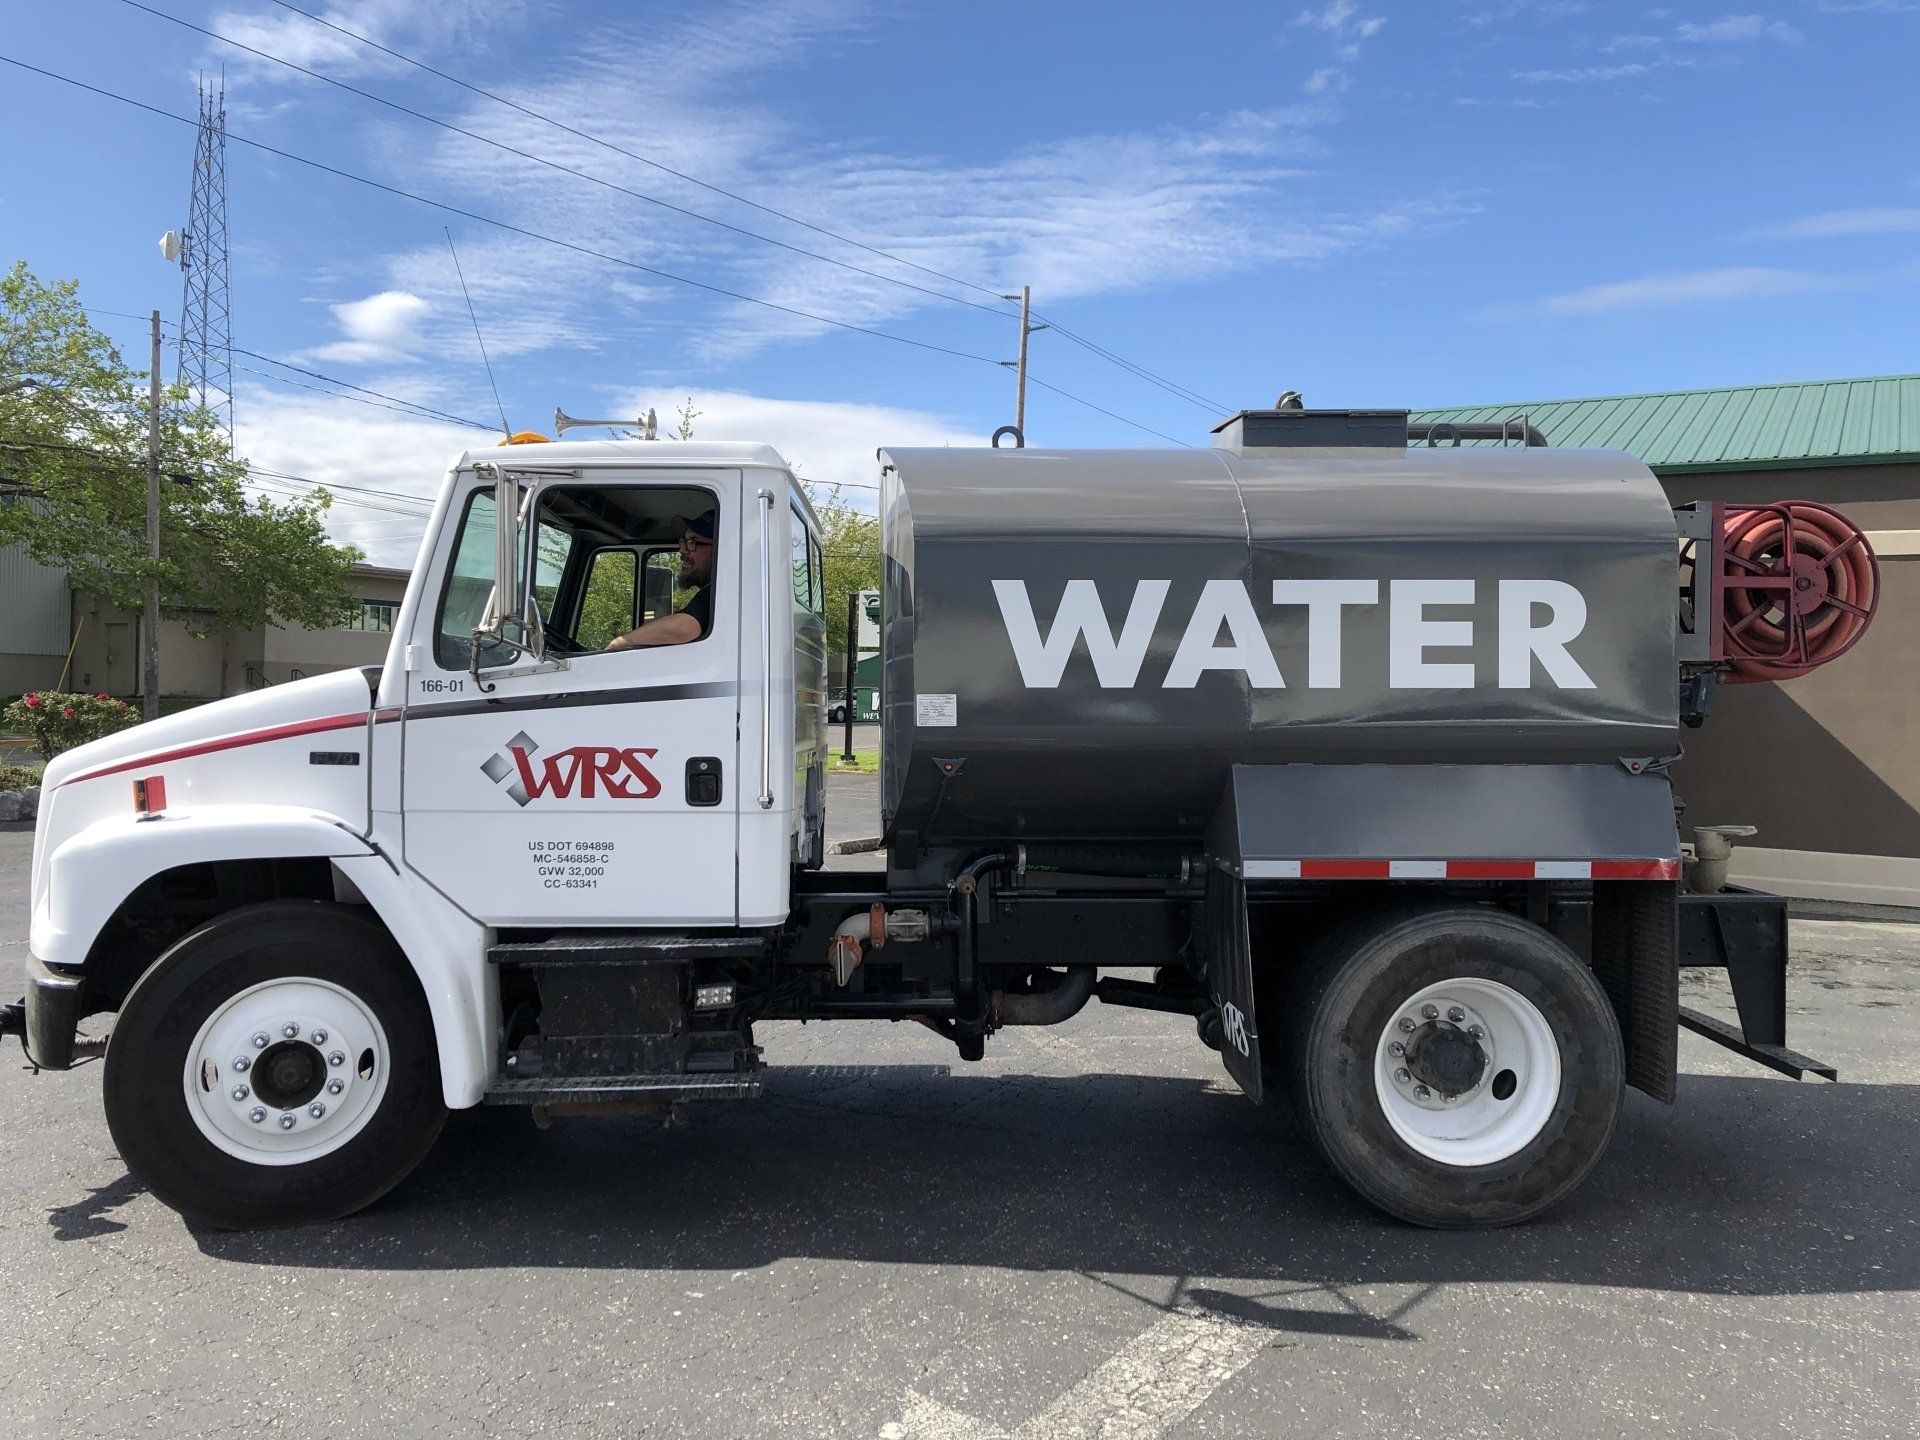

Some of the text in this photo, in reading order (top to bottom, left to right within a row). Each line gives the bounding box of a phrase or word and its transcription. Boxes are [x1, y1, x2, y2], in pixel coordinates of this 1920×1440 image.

[991, 579, 1598, 689] WATER
[420, 679, 465, 693] 166-01
[511, 746, 662, 799] WRS
[528, 841, 615, 851] US DOT 694898
[533, 854, 609, 863] MC-546858-C
[538, 866, 604, 877] GVW 32,000
[543, 879, 598, 888] CC-63341
[1217, 992, 1250, 1057] WRS
